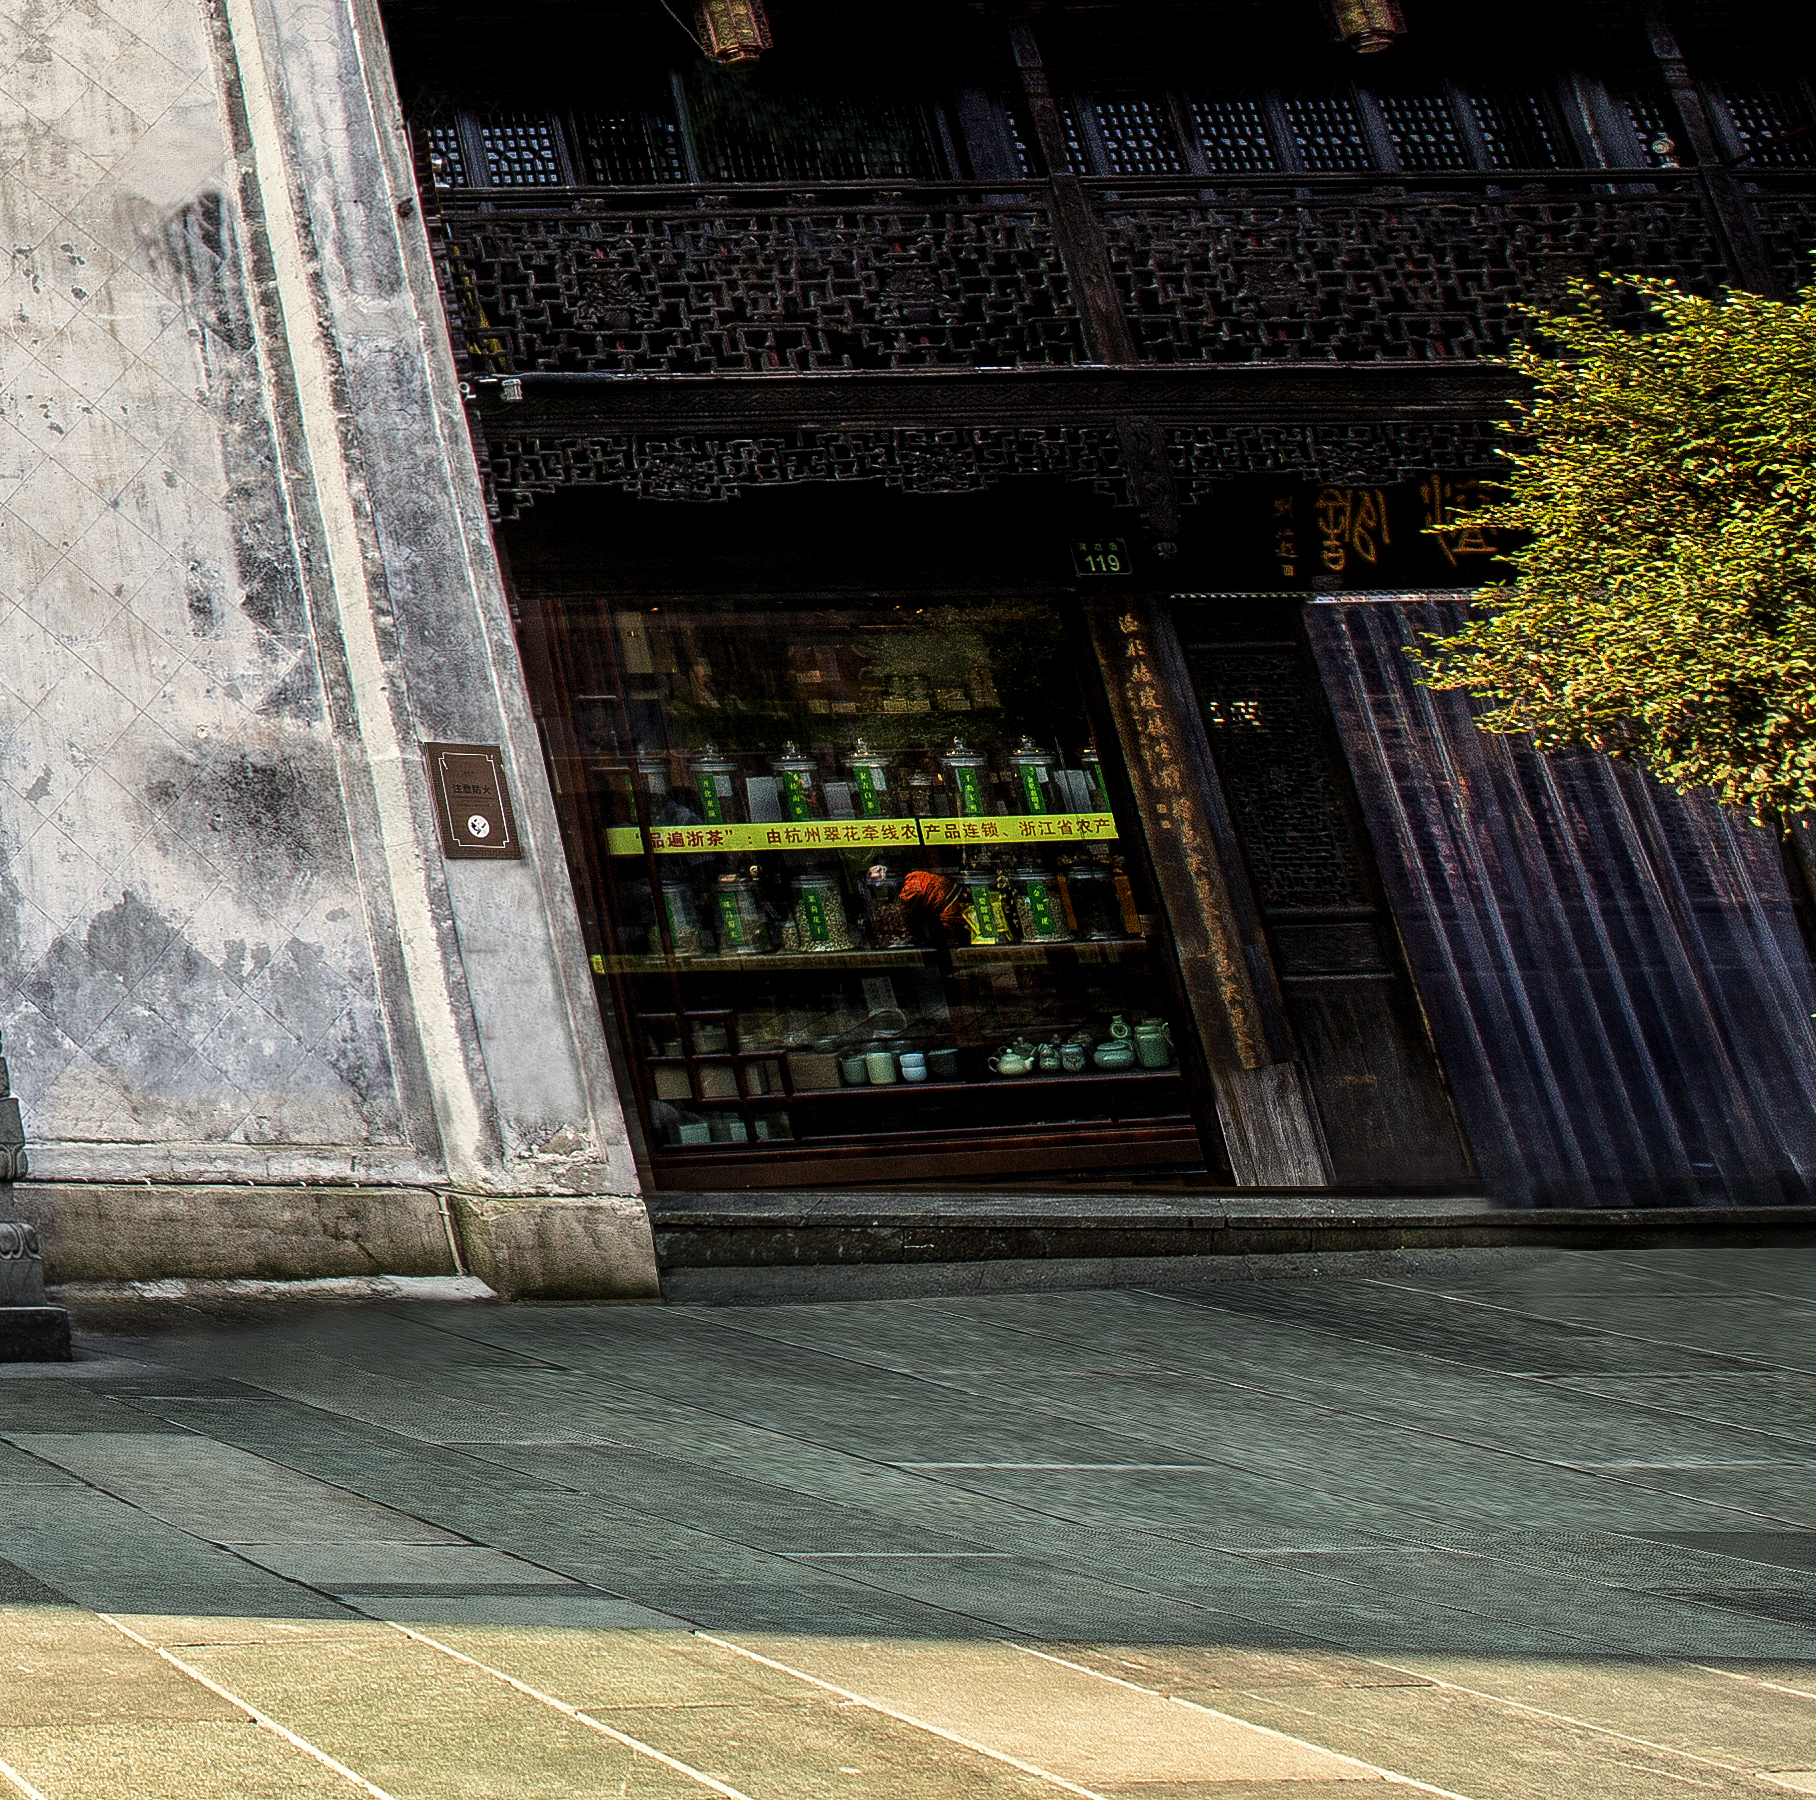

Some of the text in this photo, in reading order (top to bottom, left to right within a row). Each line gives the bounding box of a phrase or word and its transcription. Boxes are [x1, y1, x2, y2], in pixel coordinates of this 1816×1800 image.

[1085, 554, 1120, 571] 119
[452, 784, 491, 795] 注意防火
